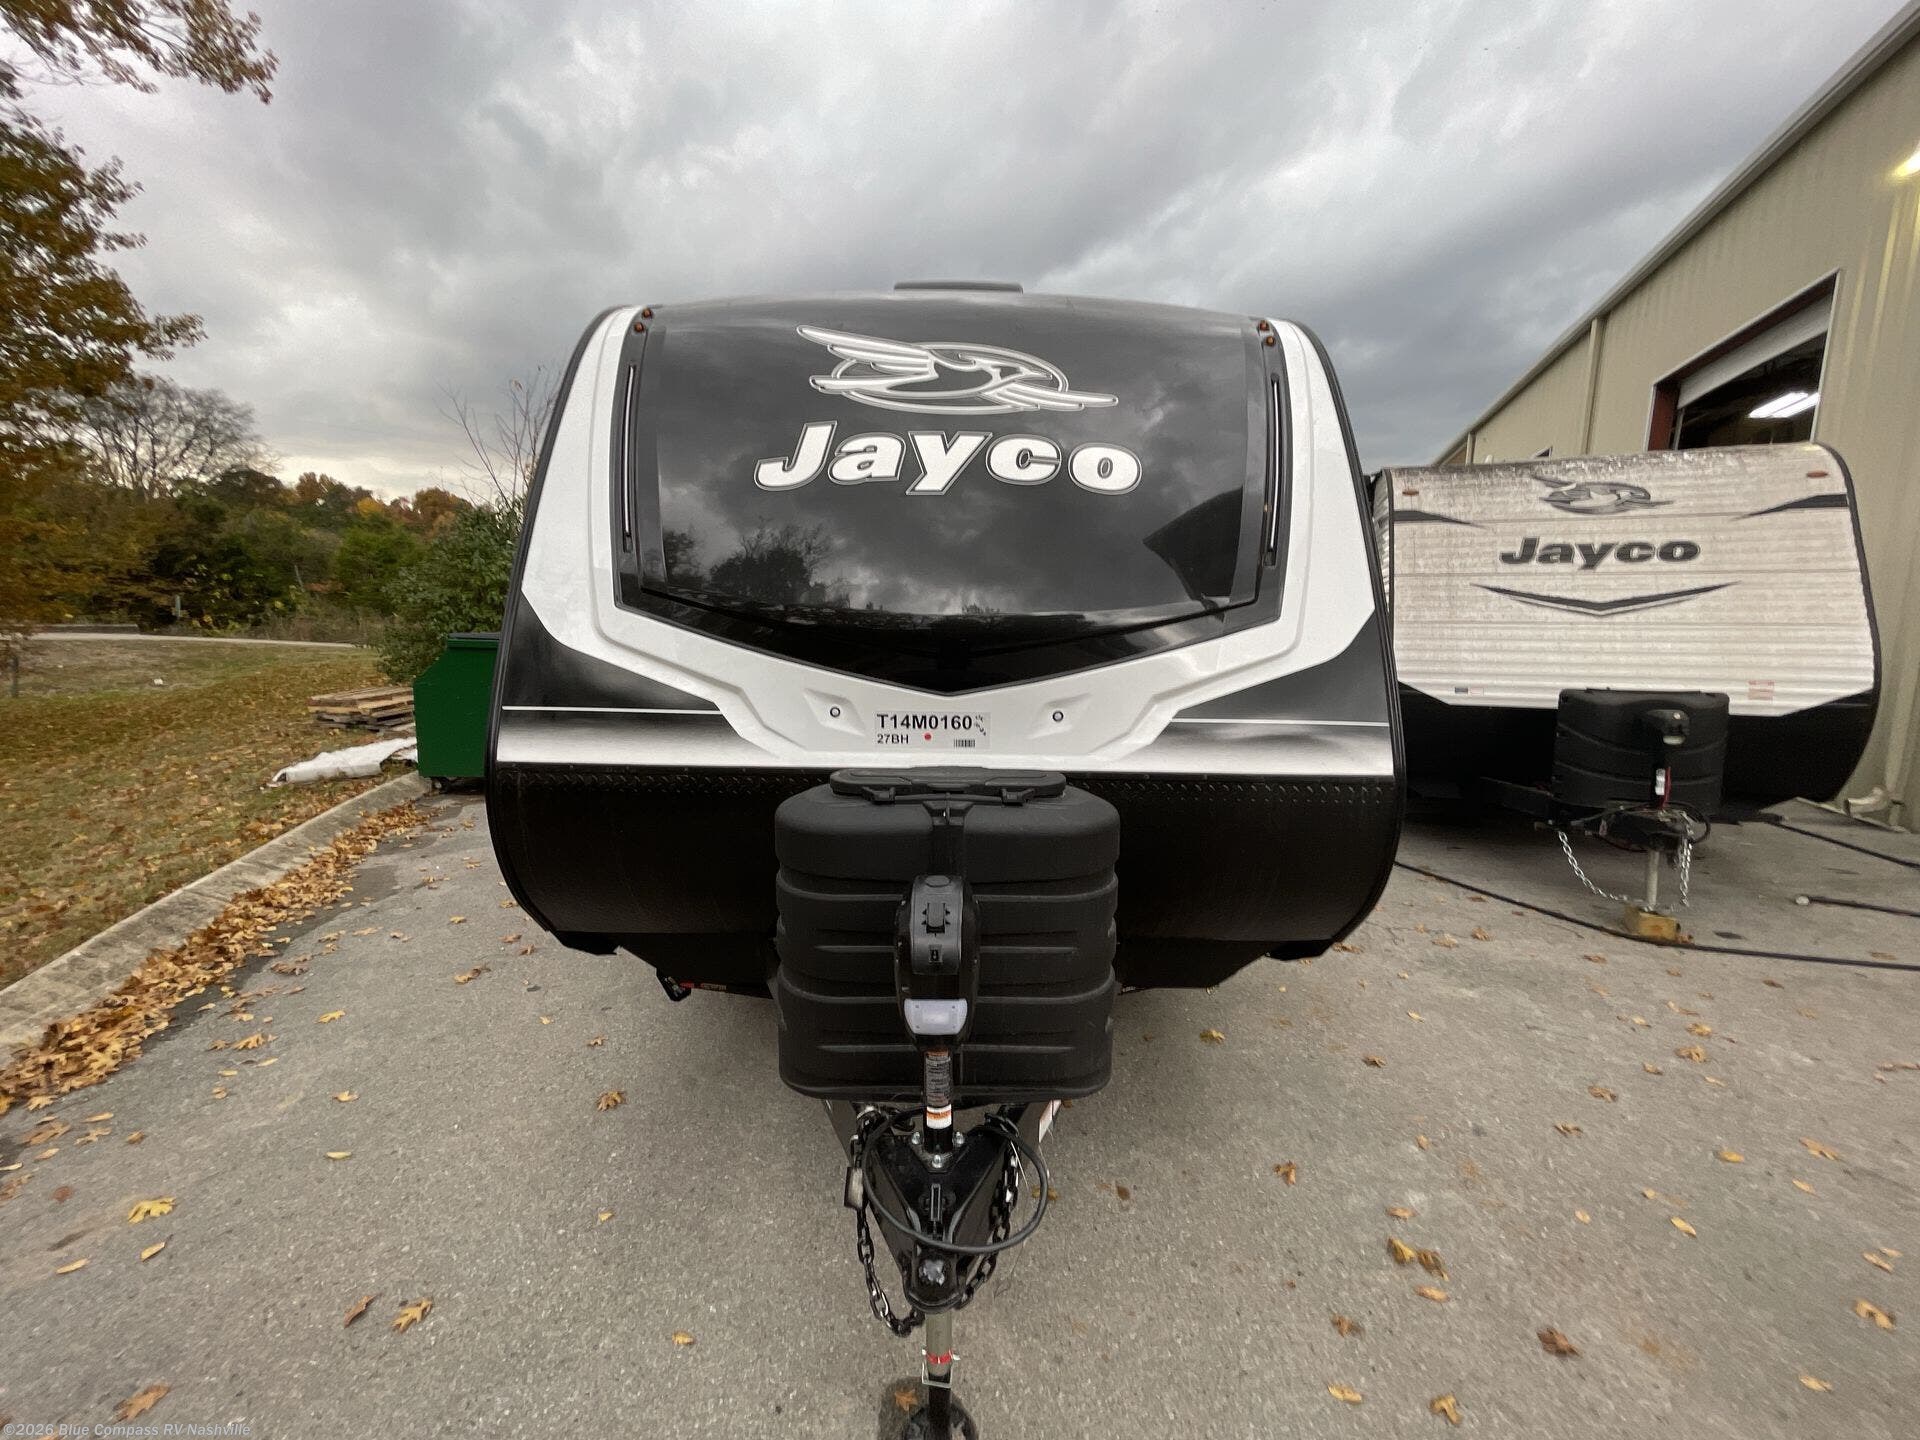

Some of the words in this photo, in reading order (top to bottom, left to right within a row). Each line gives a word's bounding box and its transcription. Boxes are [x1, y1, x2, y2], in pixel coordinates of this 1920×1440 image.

[754, 420, 1142, 496] Jayco
[1499, 536, 1701, 571] Jayco
[876, 713, 973, 730] T14M0160
[876, 733, 909, 745] 27BH
